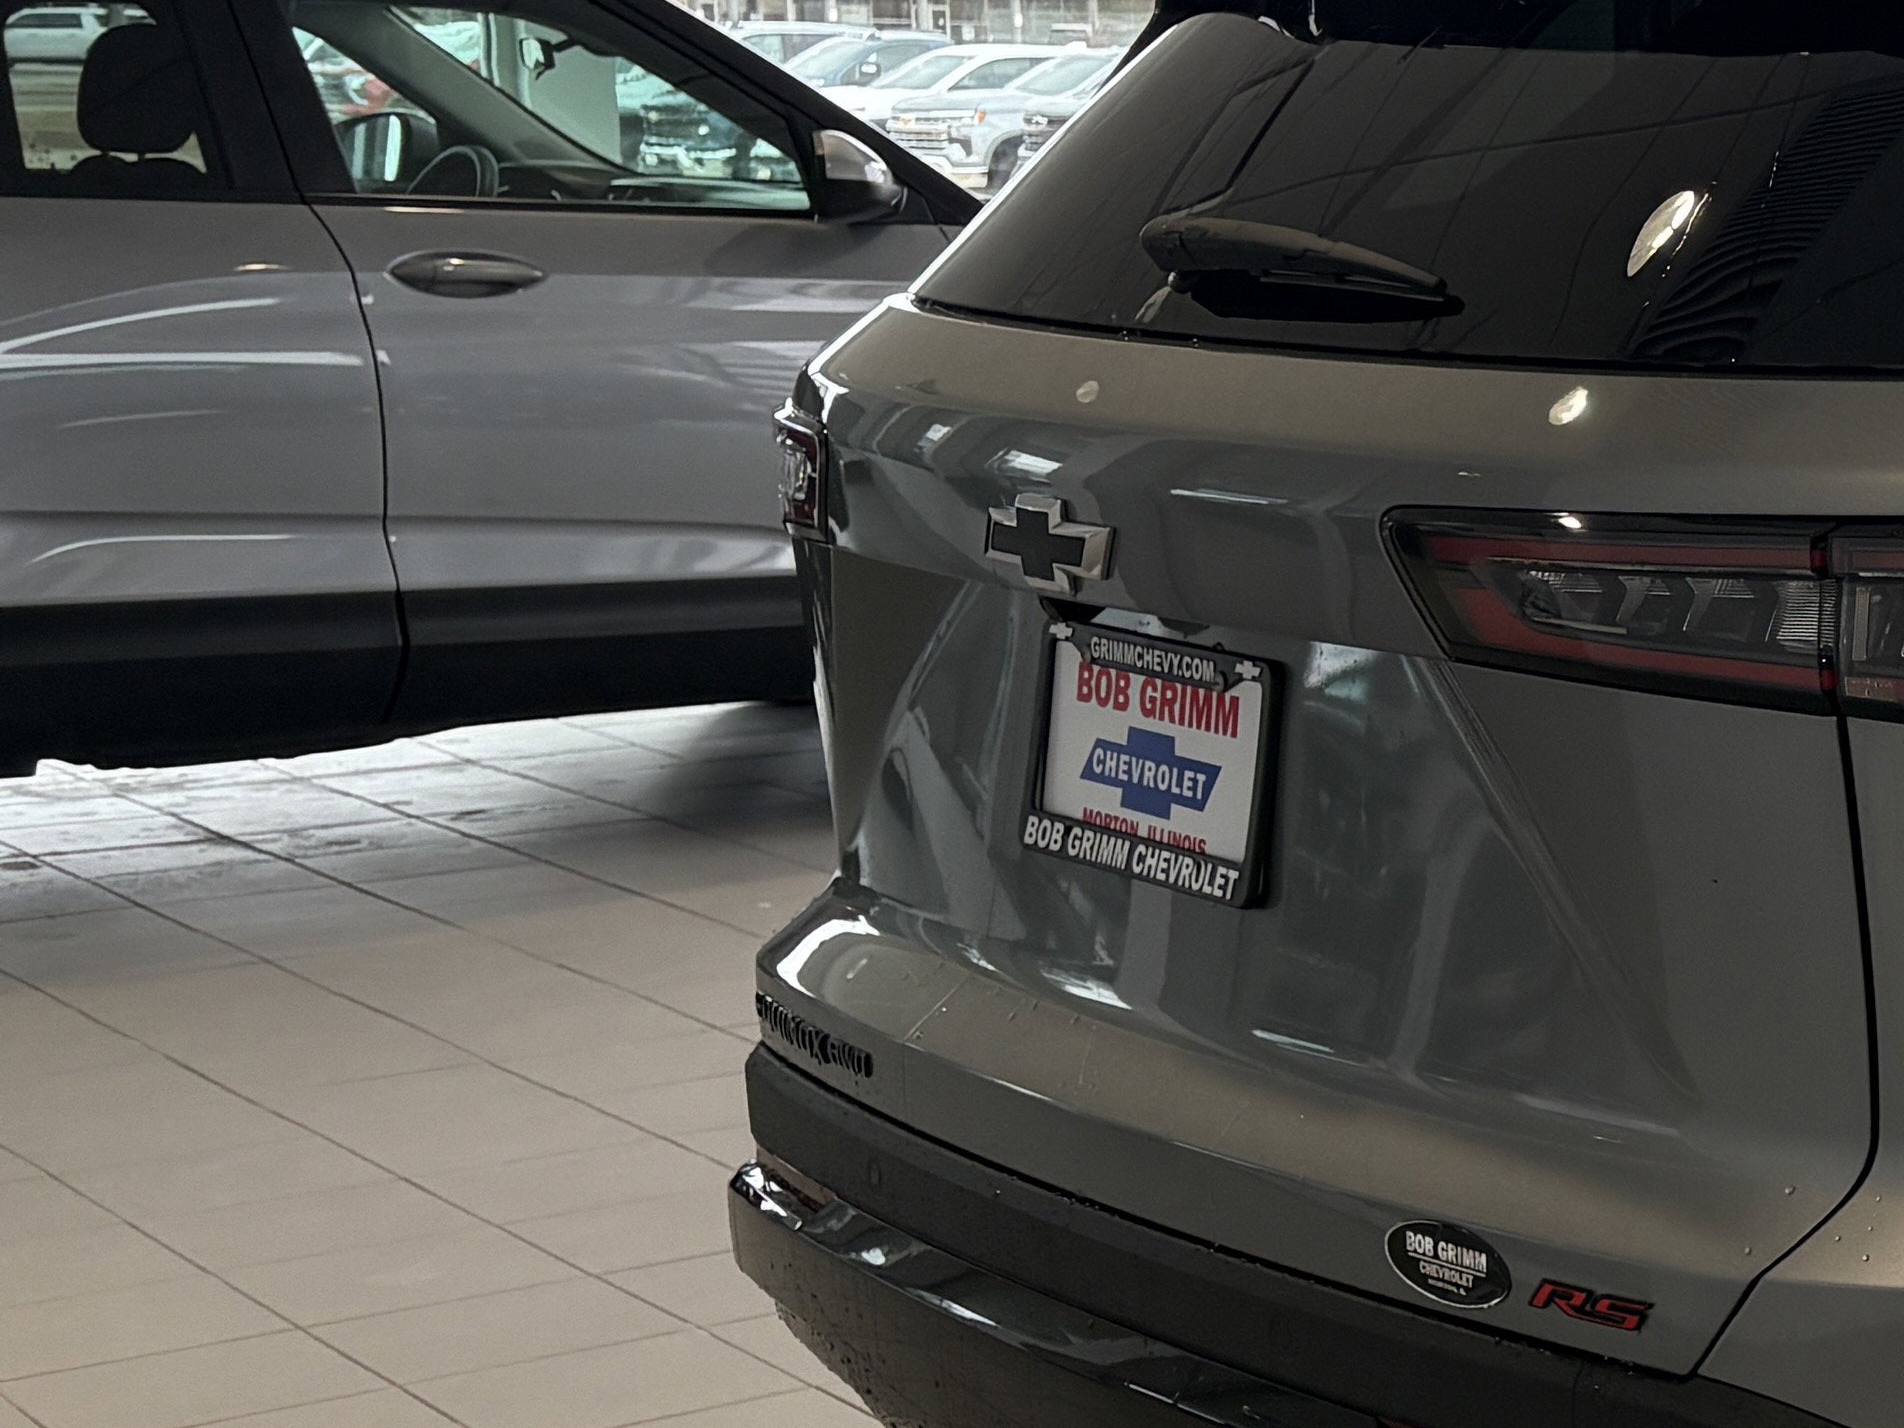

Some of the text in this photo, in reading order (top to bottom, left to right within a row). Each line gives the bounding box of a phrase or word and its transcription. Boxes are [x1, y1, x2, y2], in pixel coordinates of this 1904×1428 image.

[1090, 636, 1215, 683] GRIMMCHEVY.COM
[1076, 661, 1240, 739] BOB GRIMM
[1091, 747, 1207, 800] CHEVROLET
[1023, 815, 1240, 901] BOB GRIMM CHEVROLET
[1405, 1230, 1488, 1273] BOB GRIMM
[1418, 1260, 1475, 1289] CHEVROLET
[1527, 1277, 1655, 1332] RS
